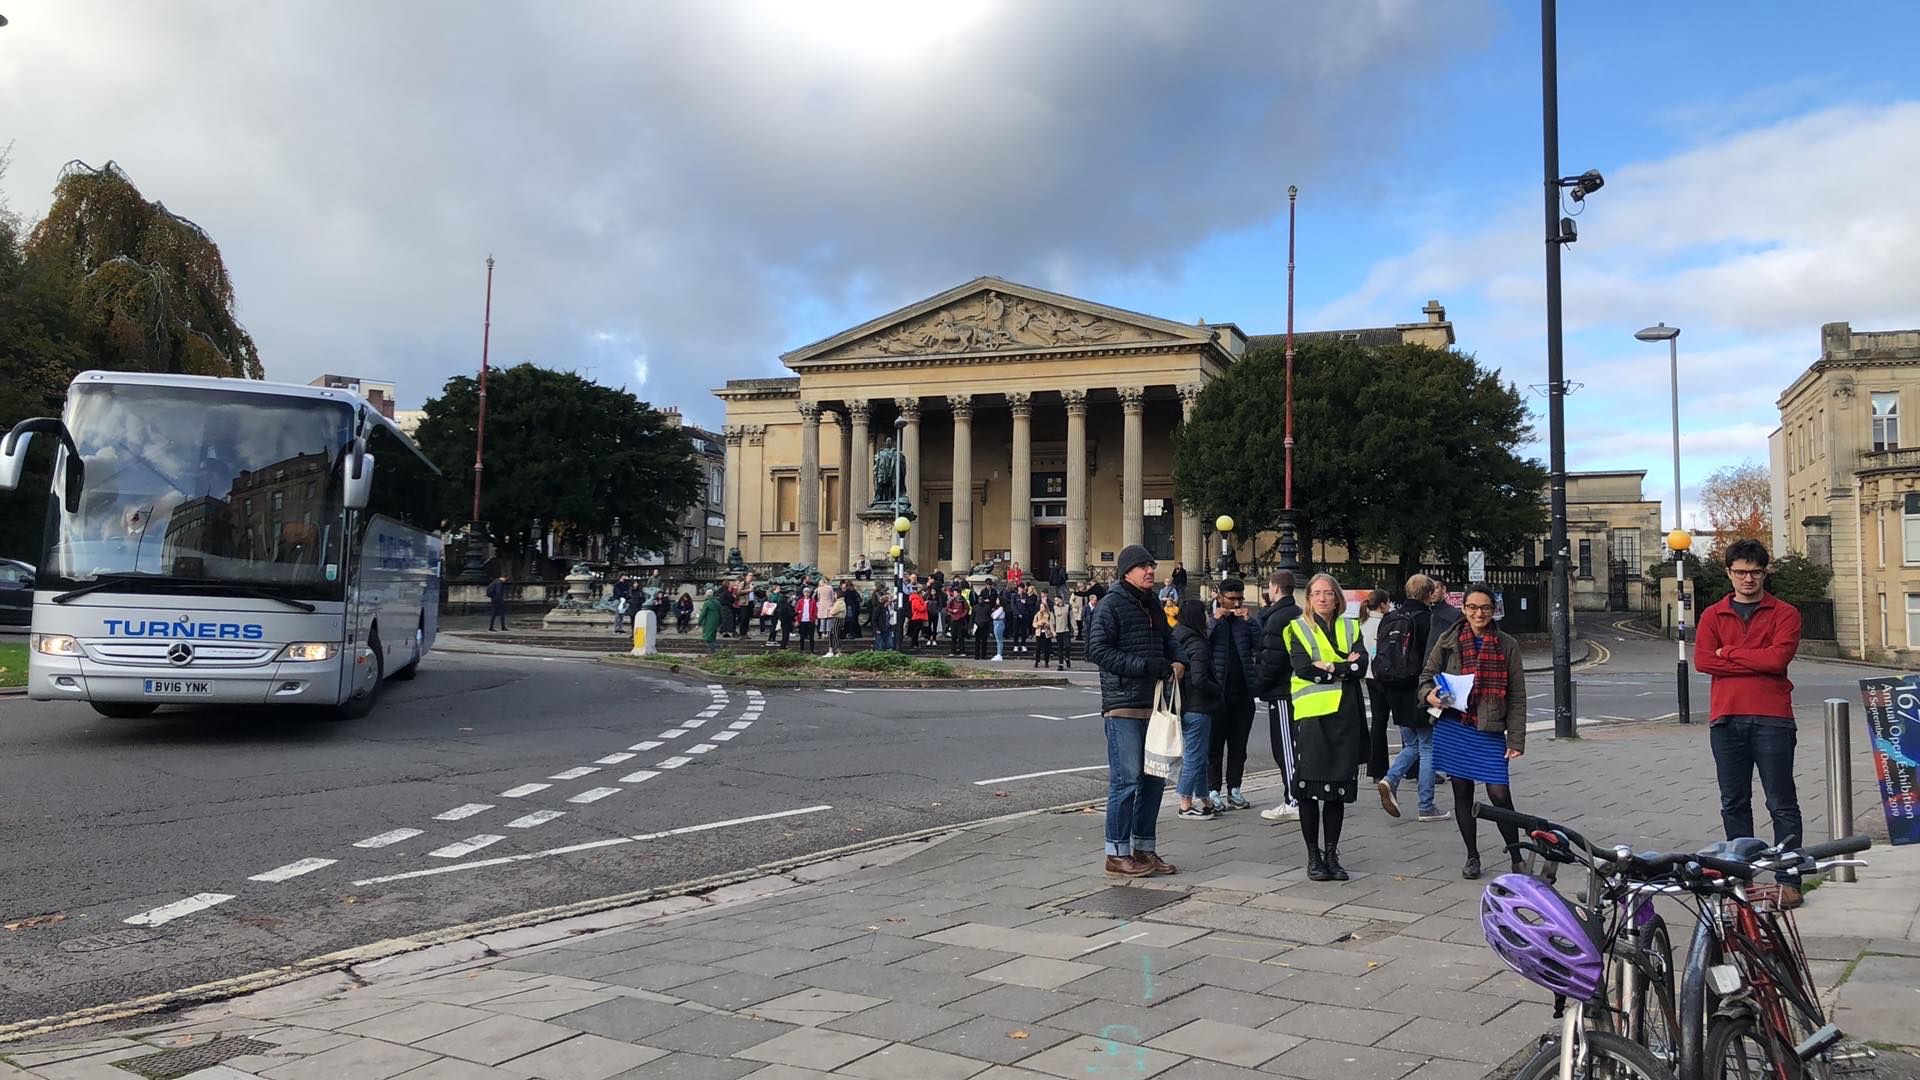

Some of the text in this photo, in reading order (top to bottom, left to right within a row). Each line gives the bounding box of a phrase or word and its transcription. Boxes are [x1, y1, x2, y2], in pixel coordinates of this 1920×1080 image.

[103, 619, 263, 639] TURNERS
[155, 682, 182, 693] BV16
[185, 682, 208, 693] YNK
[1866, 685, 1877, 696] 29
[1881, 683, 1900, 723] Annual
[1869, 697, 1884, 740] September
[1889, 725, 1903, 758] Open
[1880, 753, 1895, 795] December
[1896, 760, 1914, 819] Exhibition
[1888, 796, 1900, 817] 2019
